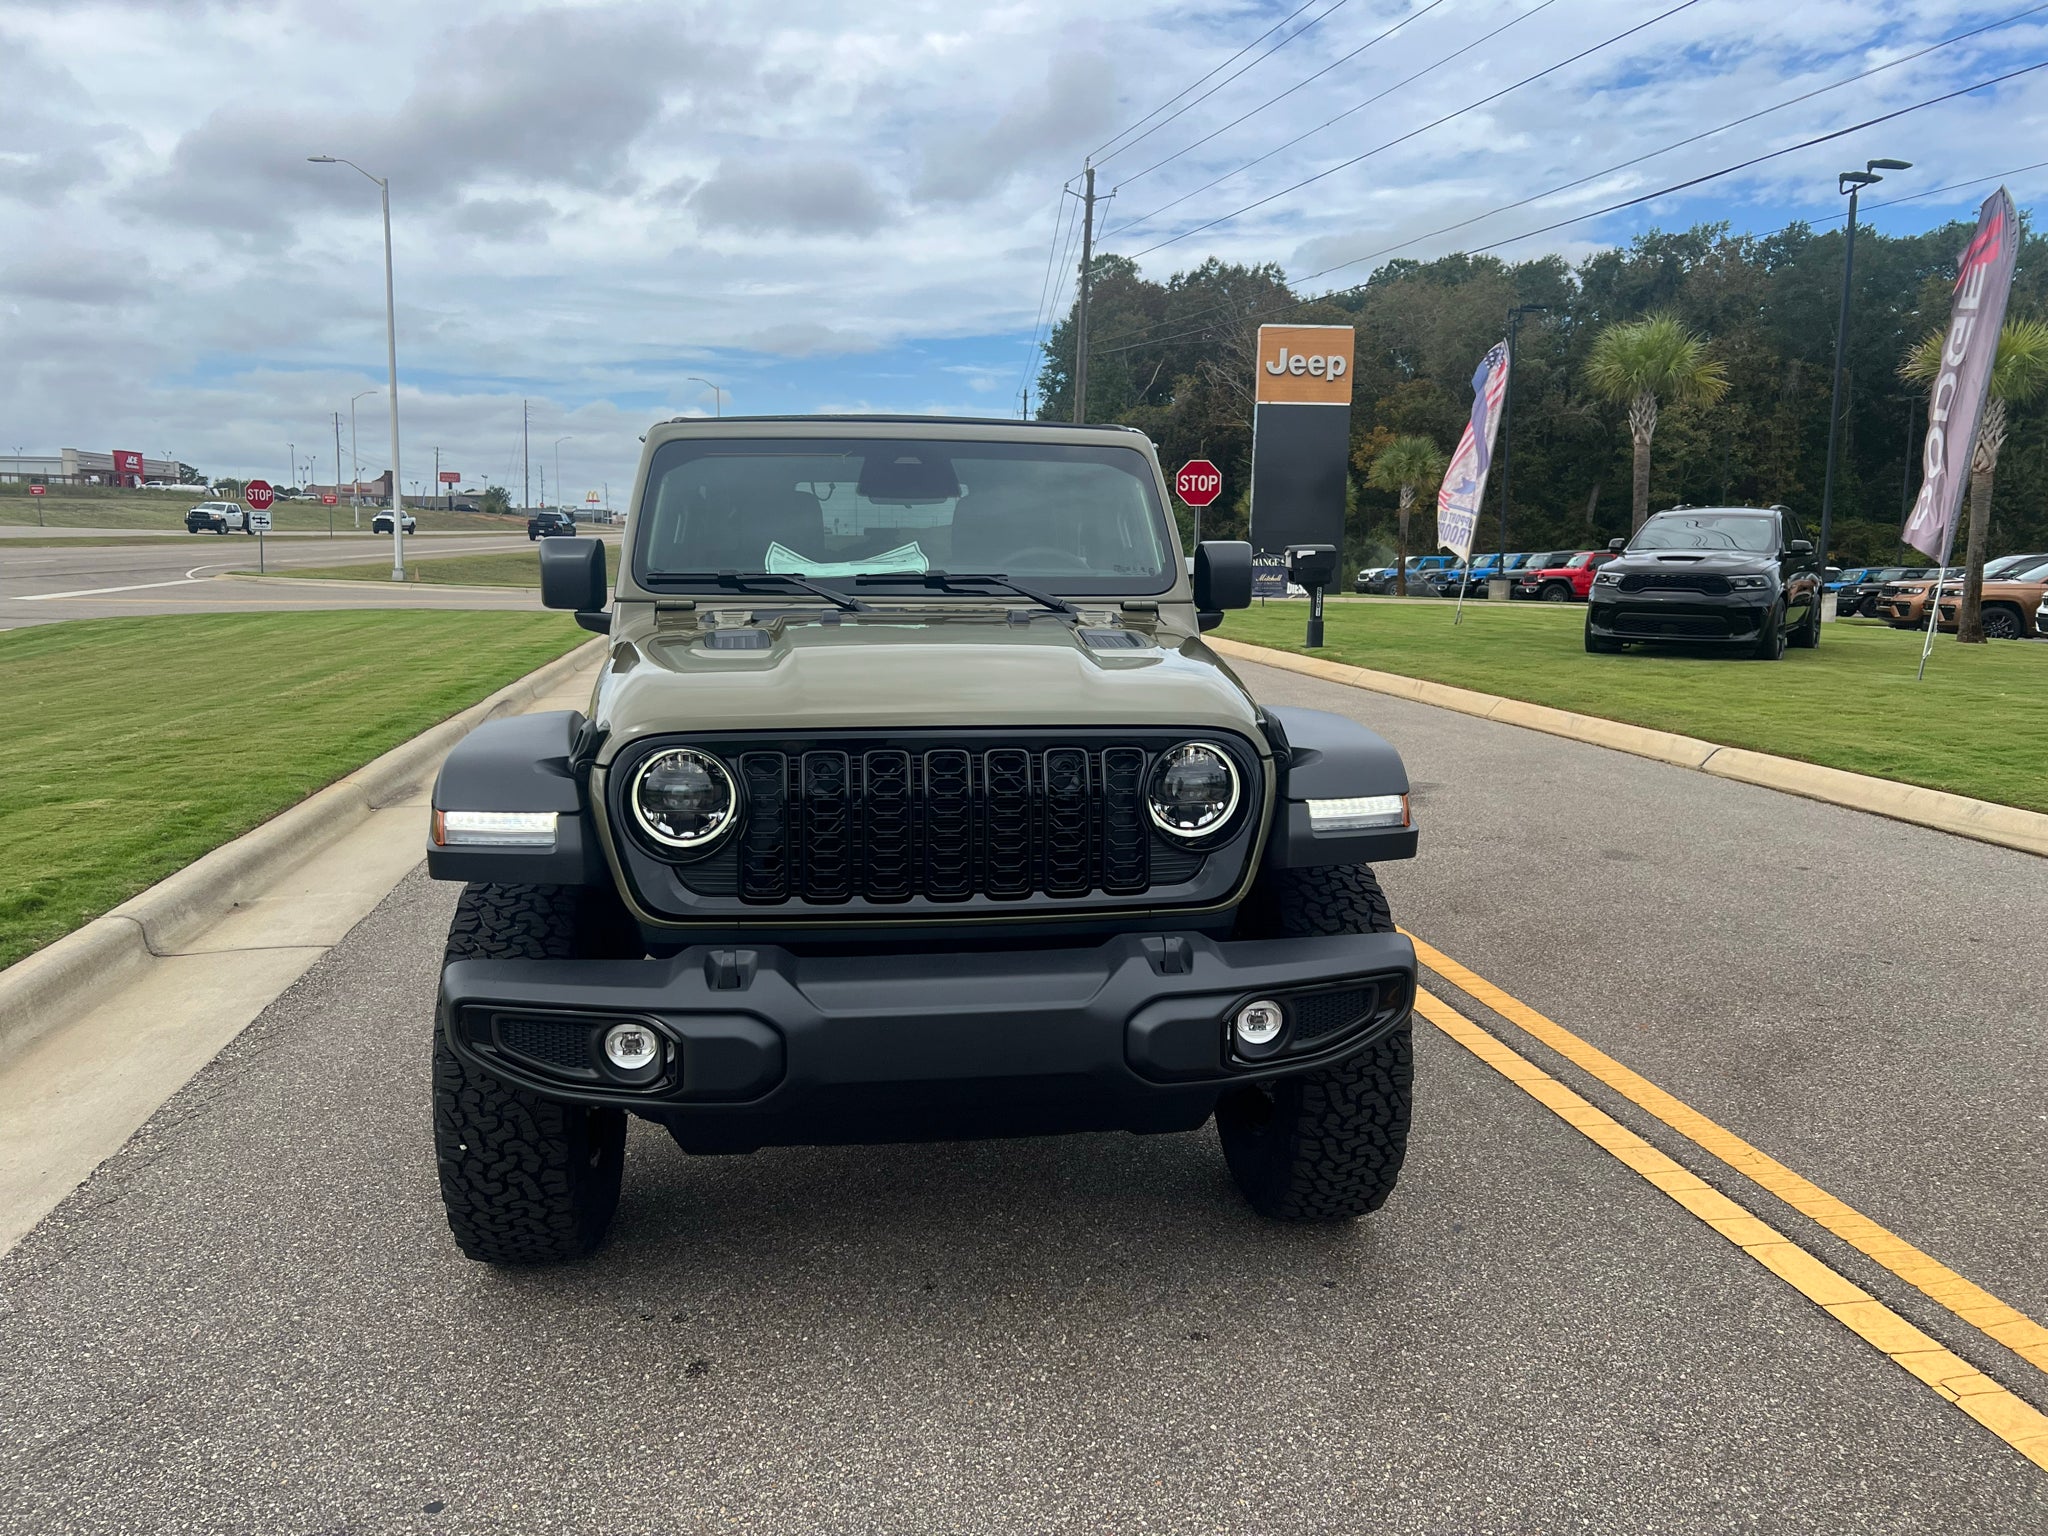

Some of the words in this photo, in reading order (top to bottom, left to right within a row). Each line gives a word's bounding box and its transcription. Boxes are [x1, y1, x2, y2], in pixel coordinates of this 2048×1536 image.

[1265, 347, 1347, 381] Jeep
[1179, 474, 1219, 492] STOP
[247, 488, 272, 501] STOP
[1252, 558, 1286, 567] HANGES
[1286, 582, 1308, 594] DIES
